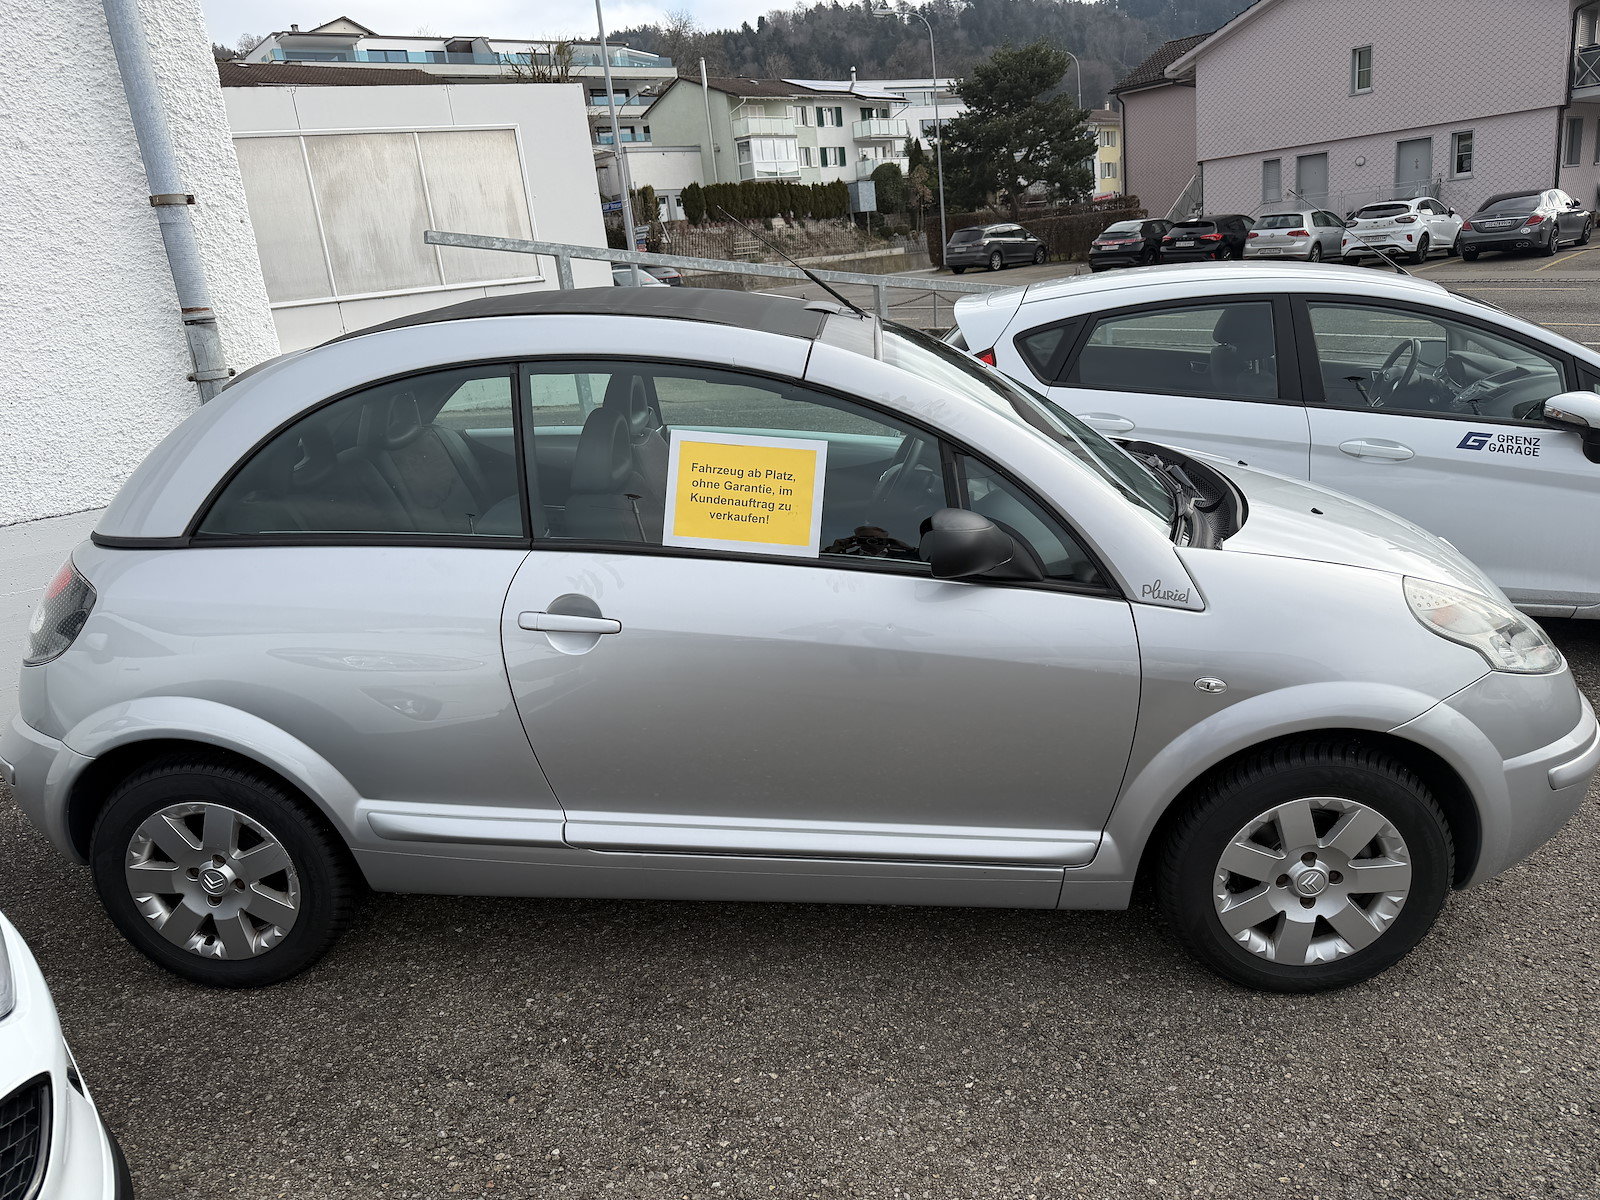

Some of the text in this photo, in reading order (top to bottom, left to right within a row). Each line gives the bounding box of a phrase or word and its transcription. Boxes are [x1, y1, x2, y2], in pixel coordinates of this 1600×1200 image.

[1497, 434, 1541, 447] GRENZ
[1488, 442, 1540, 457] GARAGE
[690, 462, 796, 482] Fahrzeug ab Platz,
[691, 478, 793, 496] ohne Garantie, im
[690, 492, 792, 512] Kundenauftrag zu
[709, 511, 770, 525] verkaufen!
